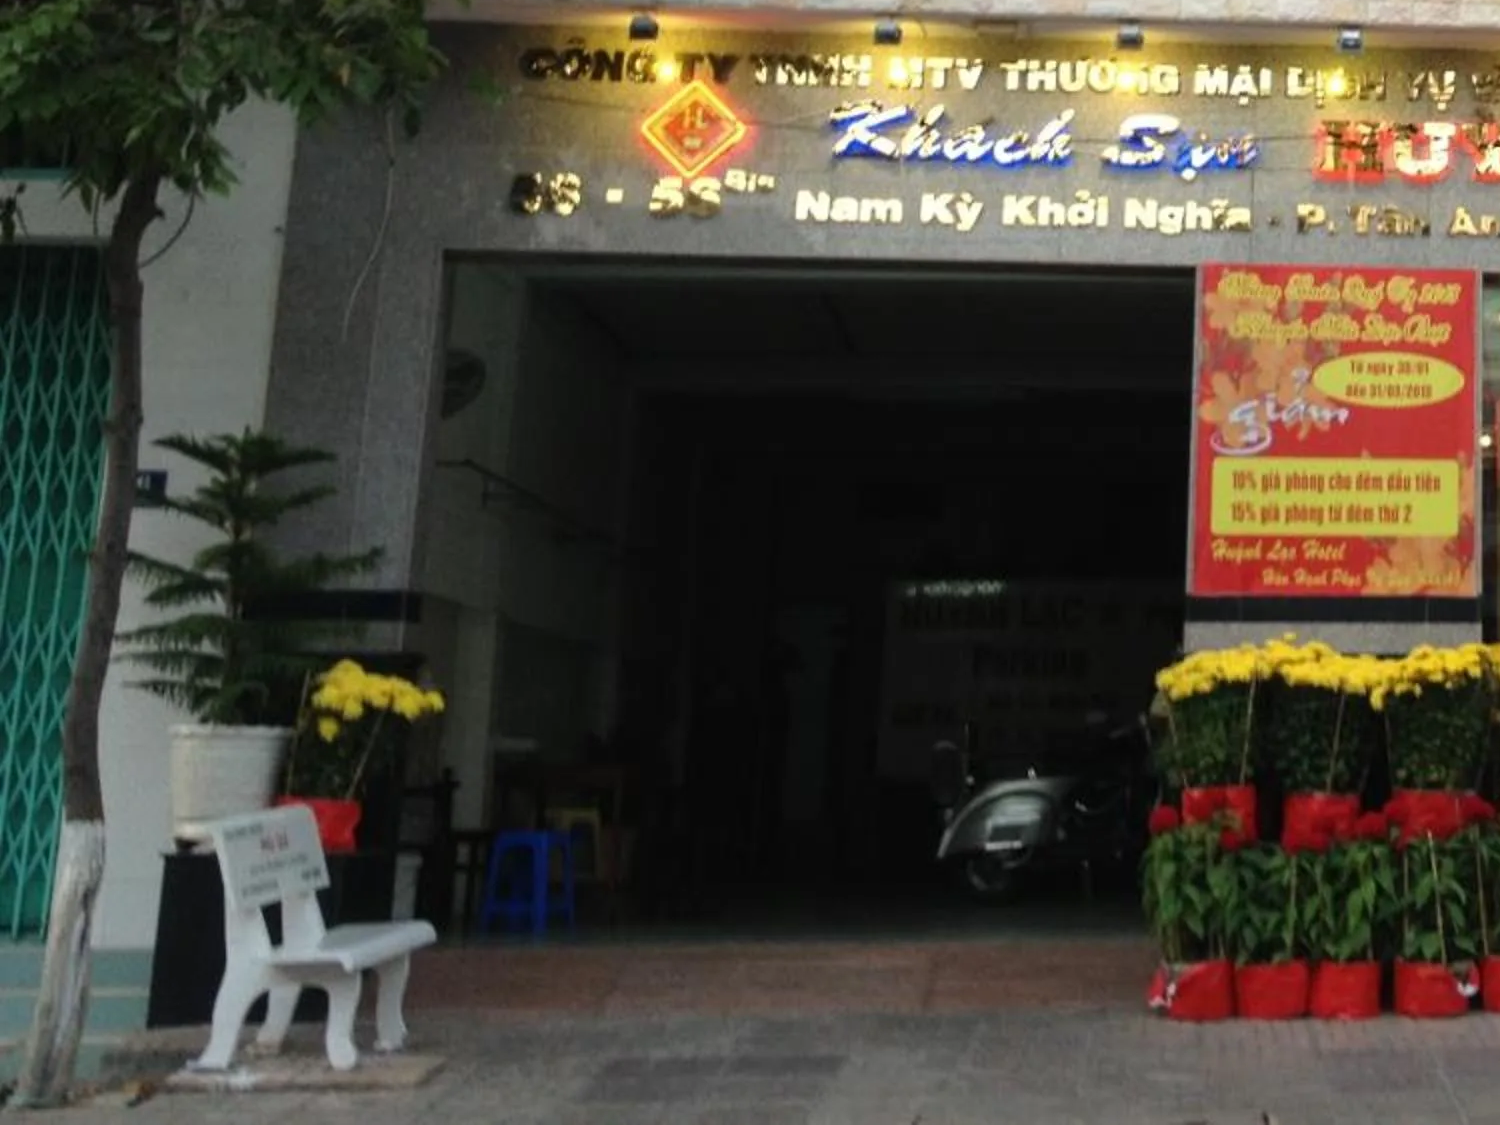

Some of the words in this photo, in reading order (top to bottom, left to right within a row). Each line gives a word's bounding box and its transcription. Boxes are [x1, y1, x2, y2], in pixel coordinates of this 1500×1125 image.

[519, 37, 657, 83] CÔNG
[676, 53, 740, 83] TY
[1193, 64, 1272, 106] MẠI
[828, 99, 1076, 165] Khách
[795, 190, 903, 223] Nam
[920, 192, 983, 231] Kỳ
[1002, 190, 1110, 229] Khởi
[1123, 197, 1252, 235] Nghĩa
[1403, 504, 1414, 523] 2
